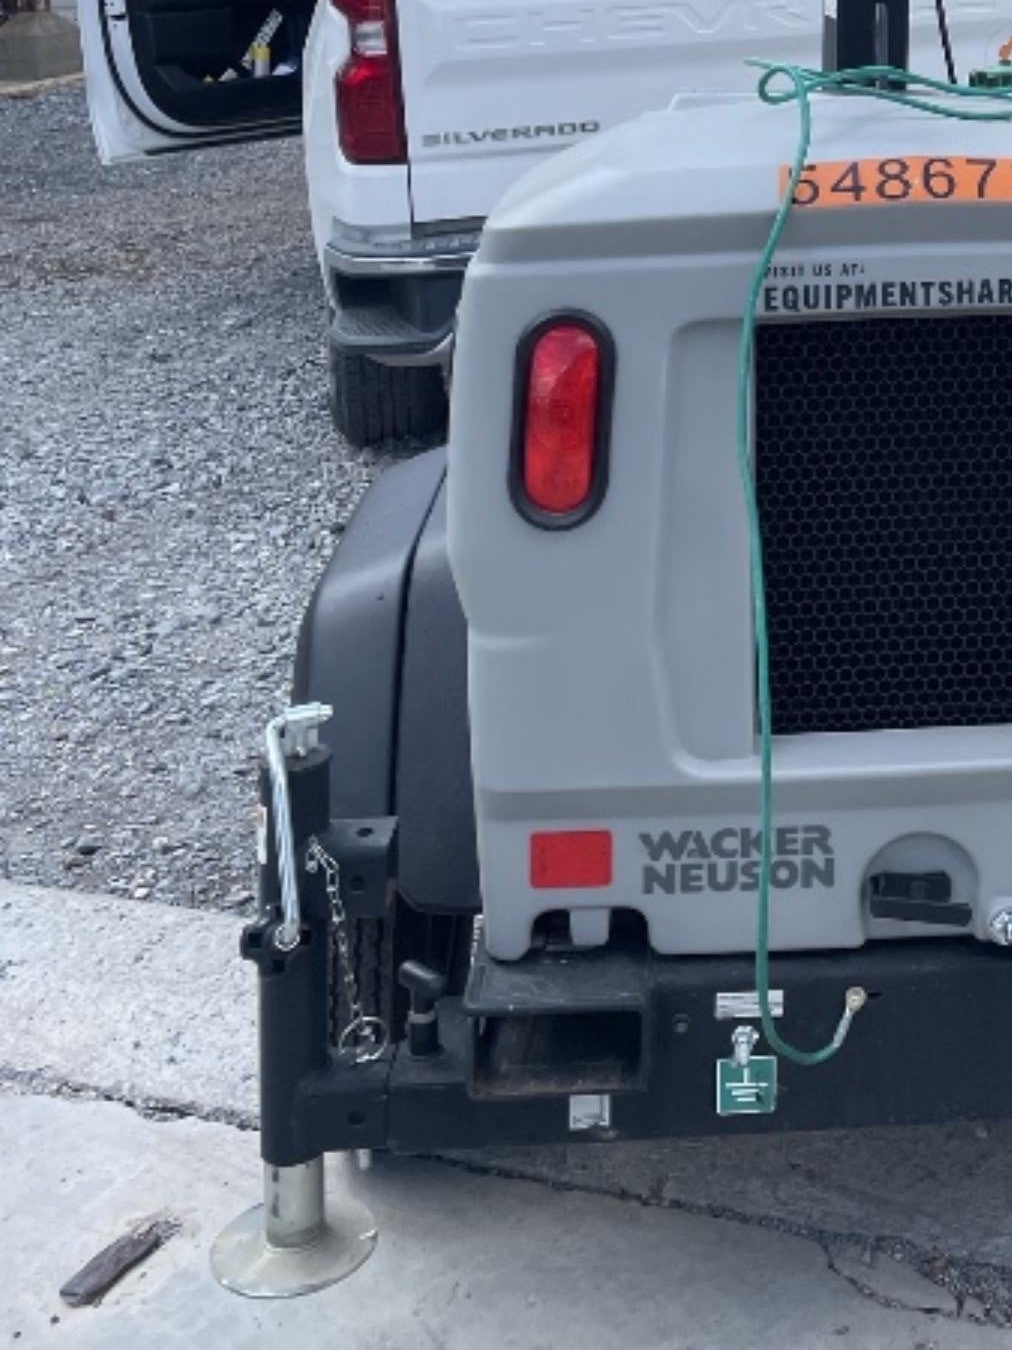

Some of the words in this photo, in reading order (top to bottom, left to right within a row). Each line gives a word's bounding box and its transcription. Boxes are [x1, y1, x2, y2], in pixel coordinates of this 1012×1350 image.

[422, 120, 600, 147] SILVERADO
[813, 263, 832, 278] US
[638, 824, 834, 862] WACKER
[642, 857, 835, 895] NEUSON
